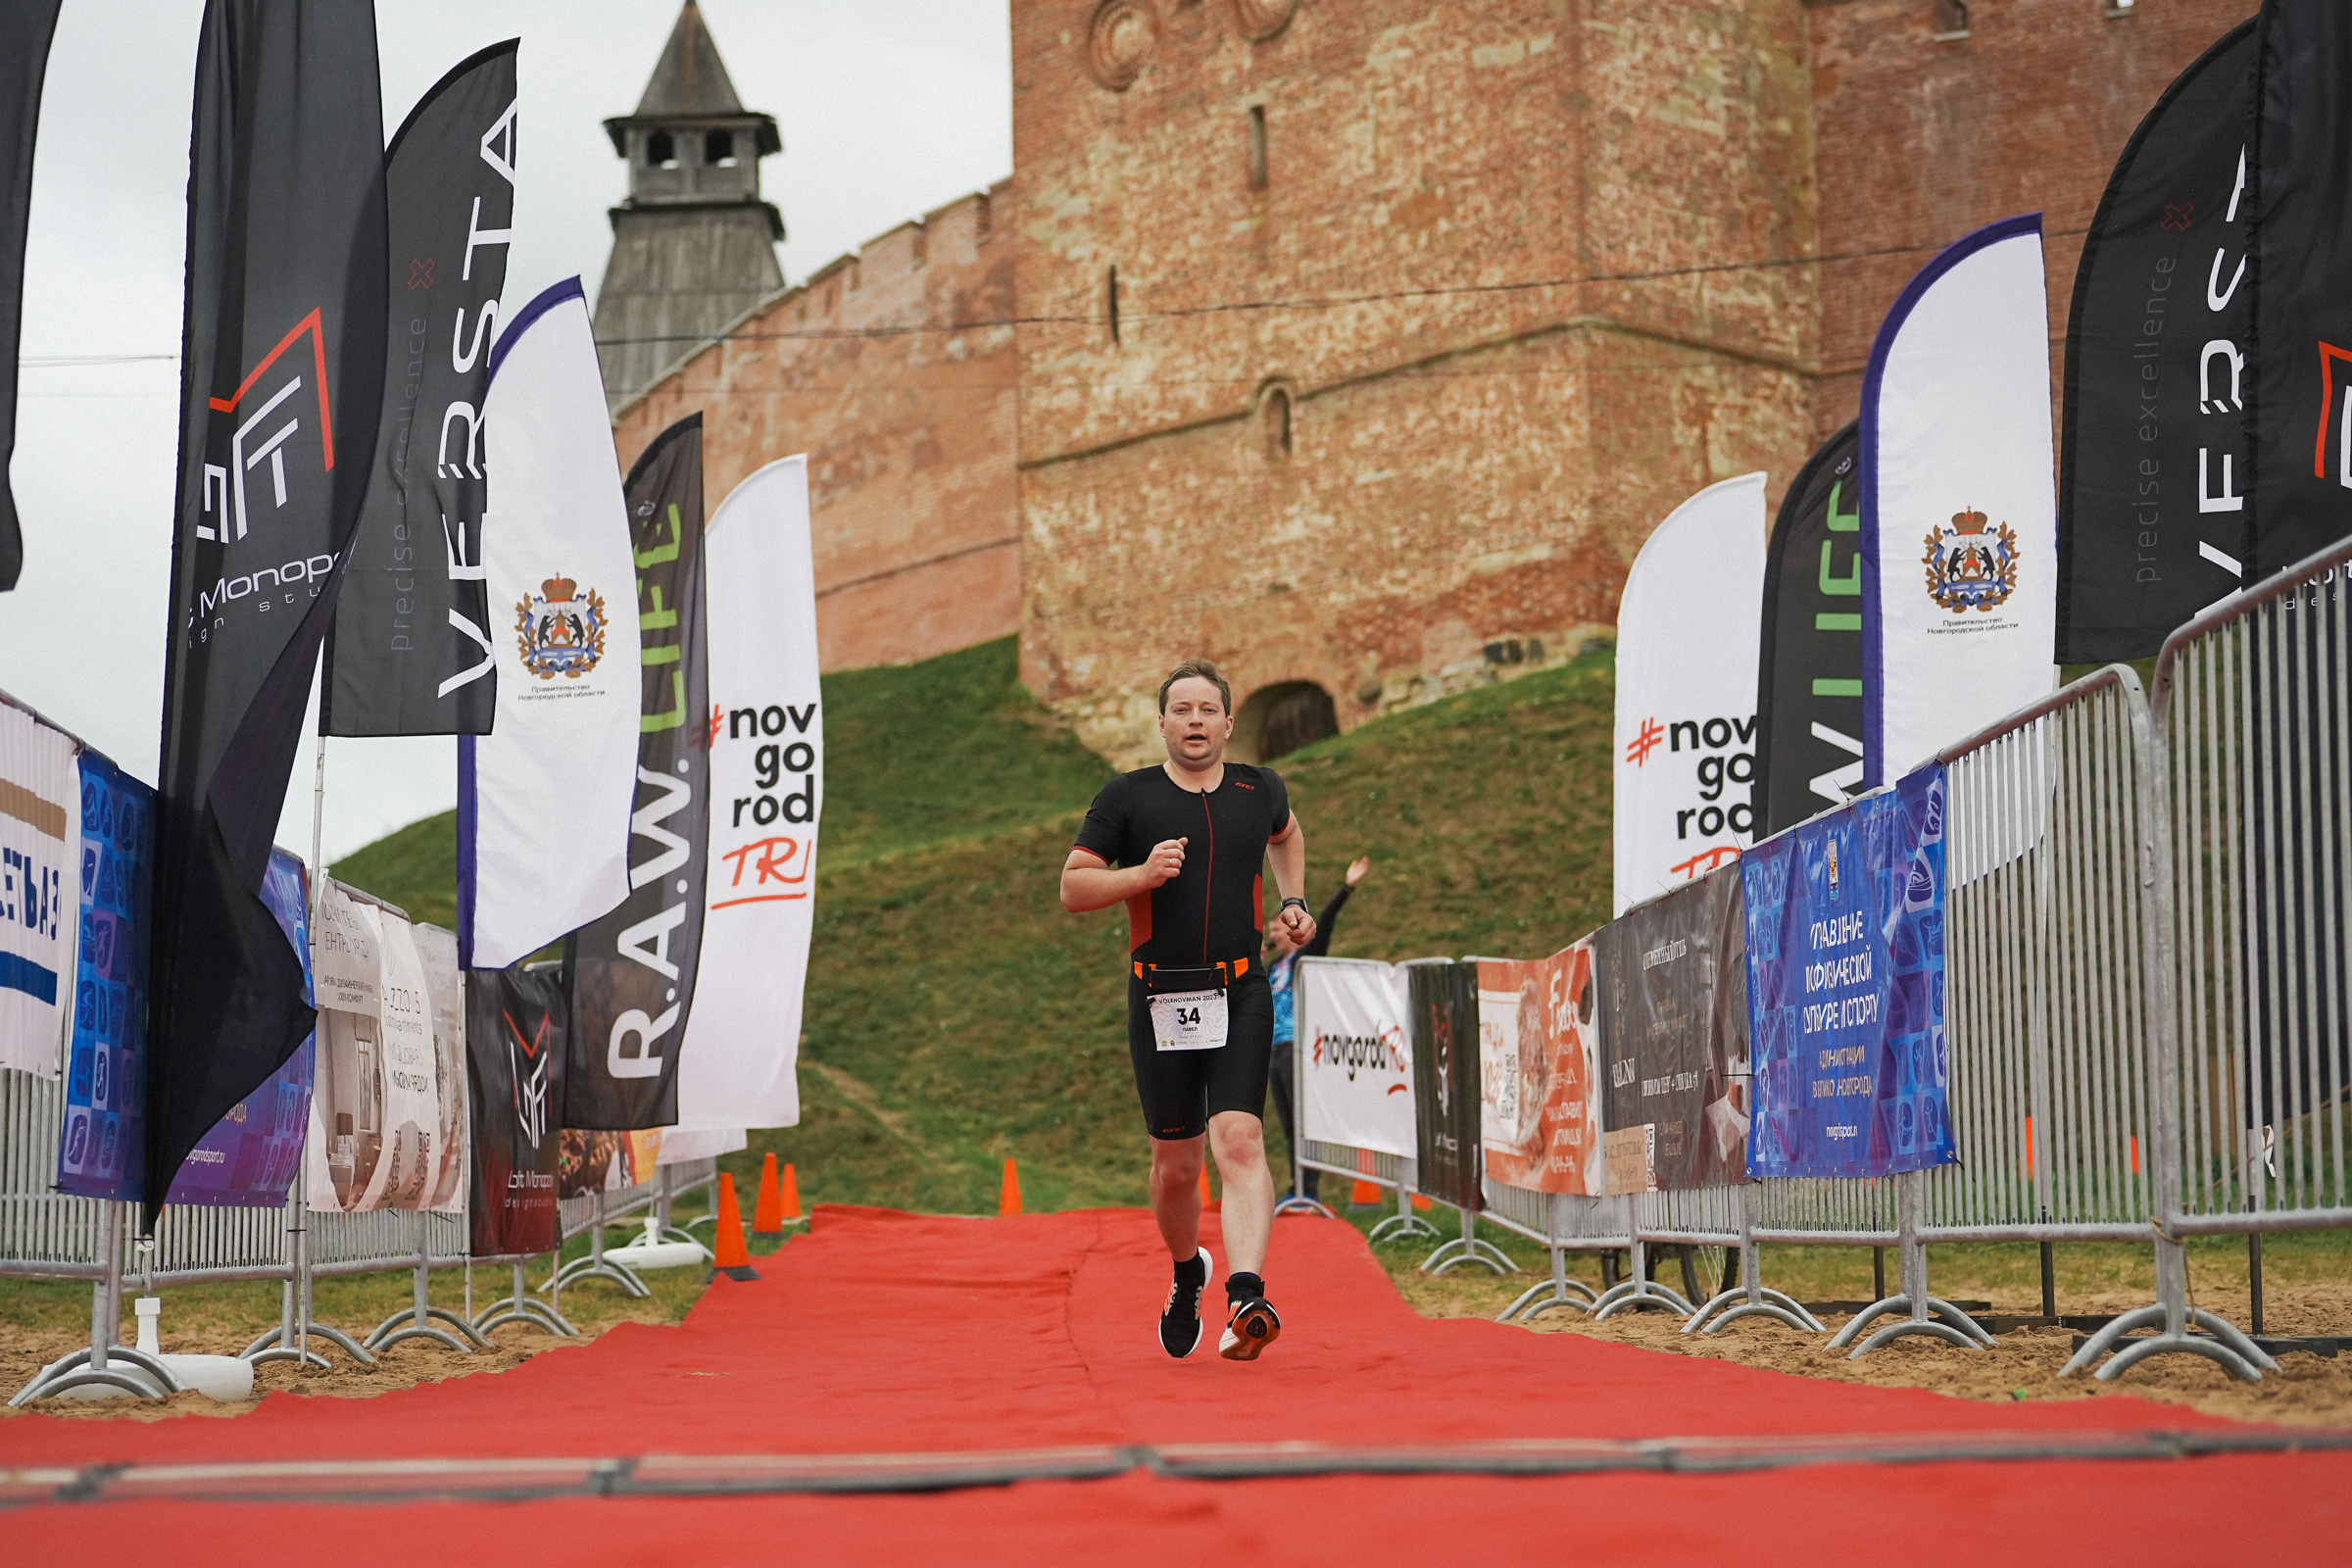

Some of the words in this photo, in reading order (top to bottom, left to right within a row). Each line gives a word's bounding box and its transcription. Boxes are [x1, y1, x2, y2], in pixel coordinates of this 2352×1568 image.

[2133, 256, 2177, 442] excellence
[2132, 459, 2162, 583] precise
[200, 551, 341, 618] Monop
[387, 522, 416, 651] precise
[1927, 626, 1984, 635] Новгородской
[1985, 622, 2019, 632] области
[1942, 616, 2003, 627] Правительство
[517, 692, 572, 701] Новгородской
[531, 684, 591, 694] Правительство
[755, 742, 814, 789] go
[1697, 753, 1755, 802] go
[733, 774, 814, 827] rod
[1158, 995, 1201, 1004] VOLKHOVMAN
[1176, 1007, 1200, 1025] 34
